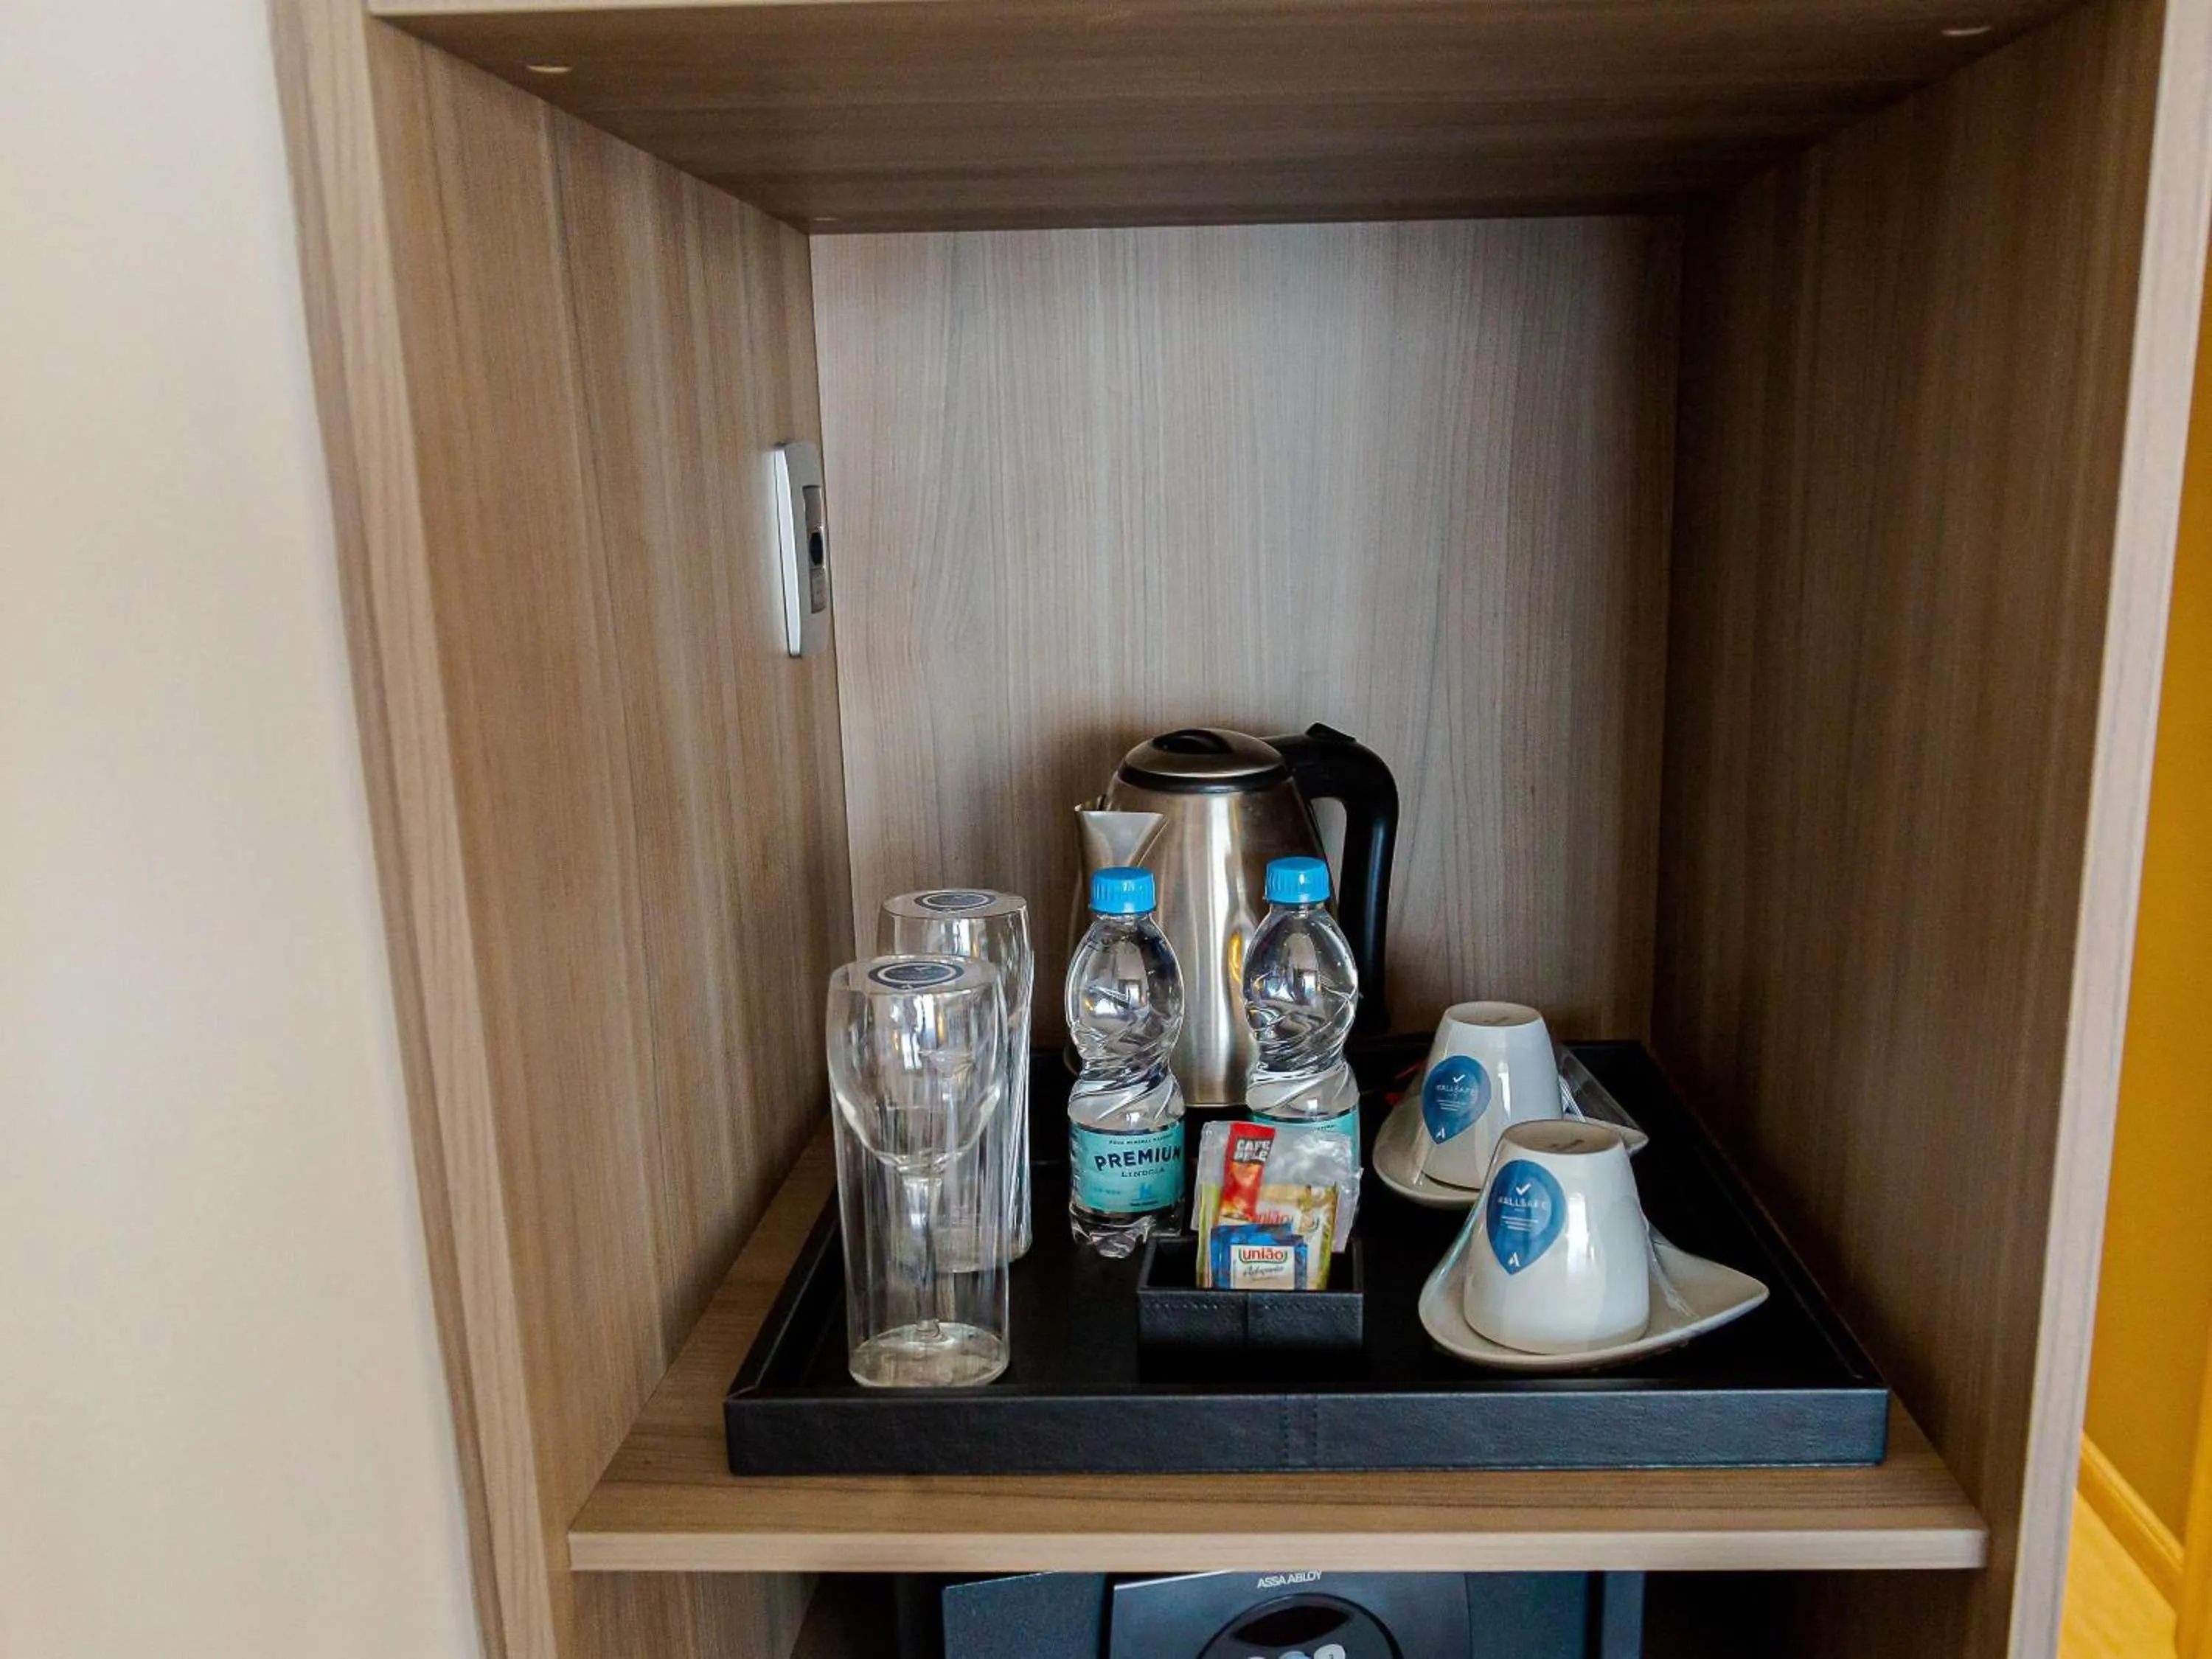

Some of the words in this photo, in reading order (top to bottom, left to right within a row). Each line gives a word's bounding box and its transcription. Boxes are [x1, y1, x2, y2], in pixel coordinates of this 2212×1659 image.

[1094, 1145, 1180, 1172] PREMIUM
[1257, 1575, 1287, 1589] ASSA
[1287, 1569, 1322, 1585] ABLOY
